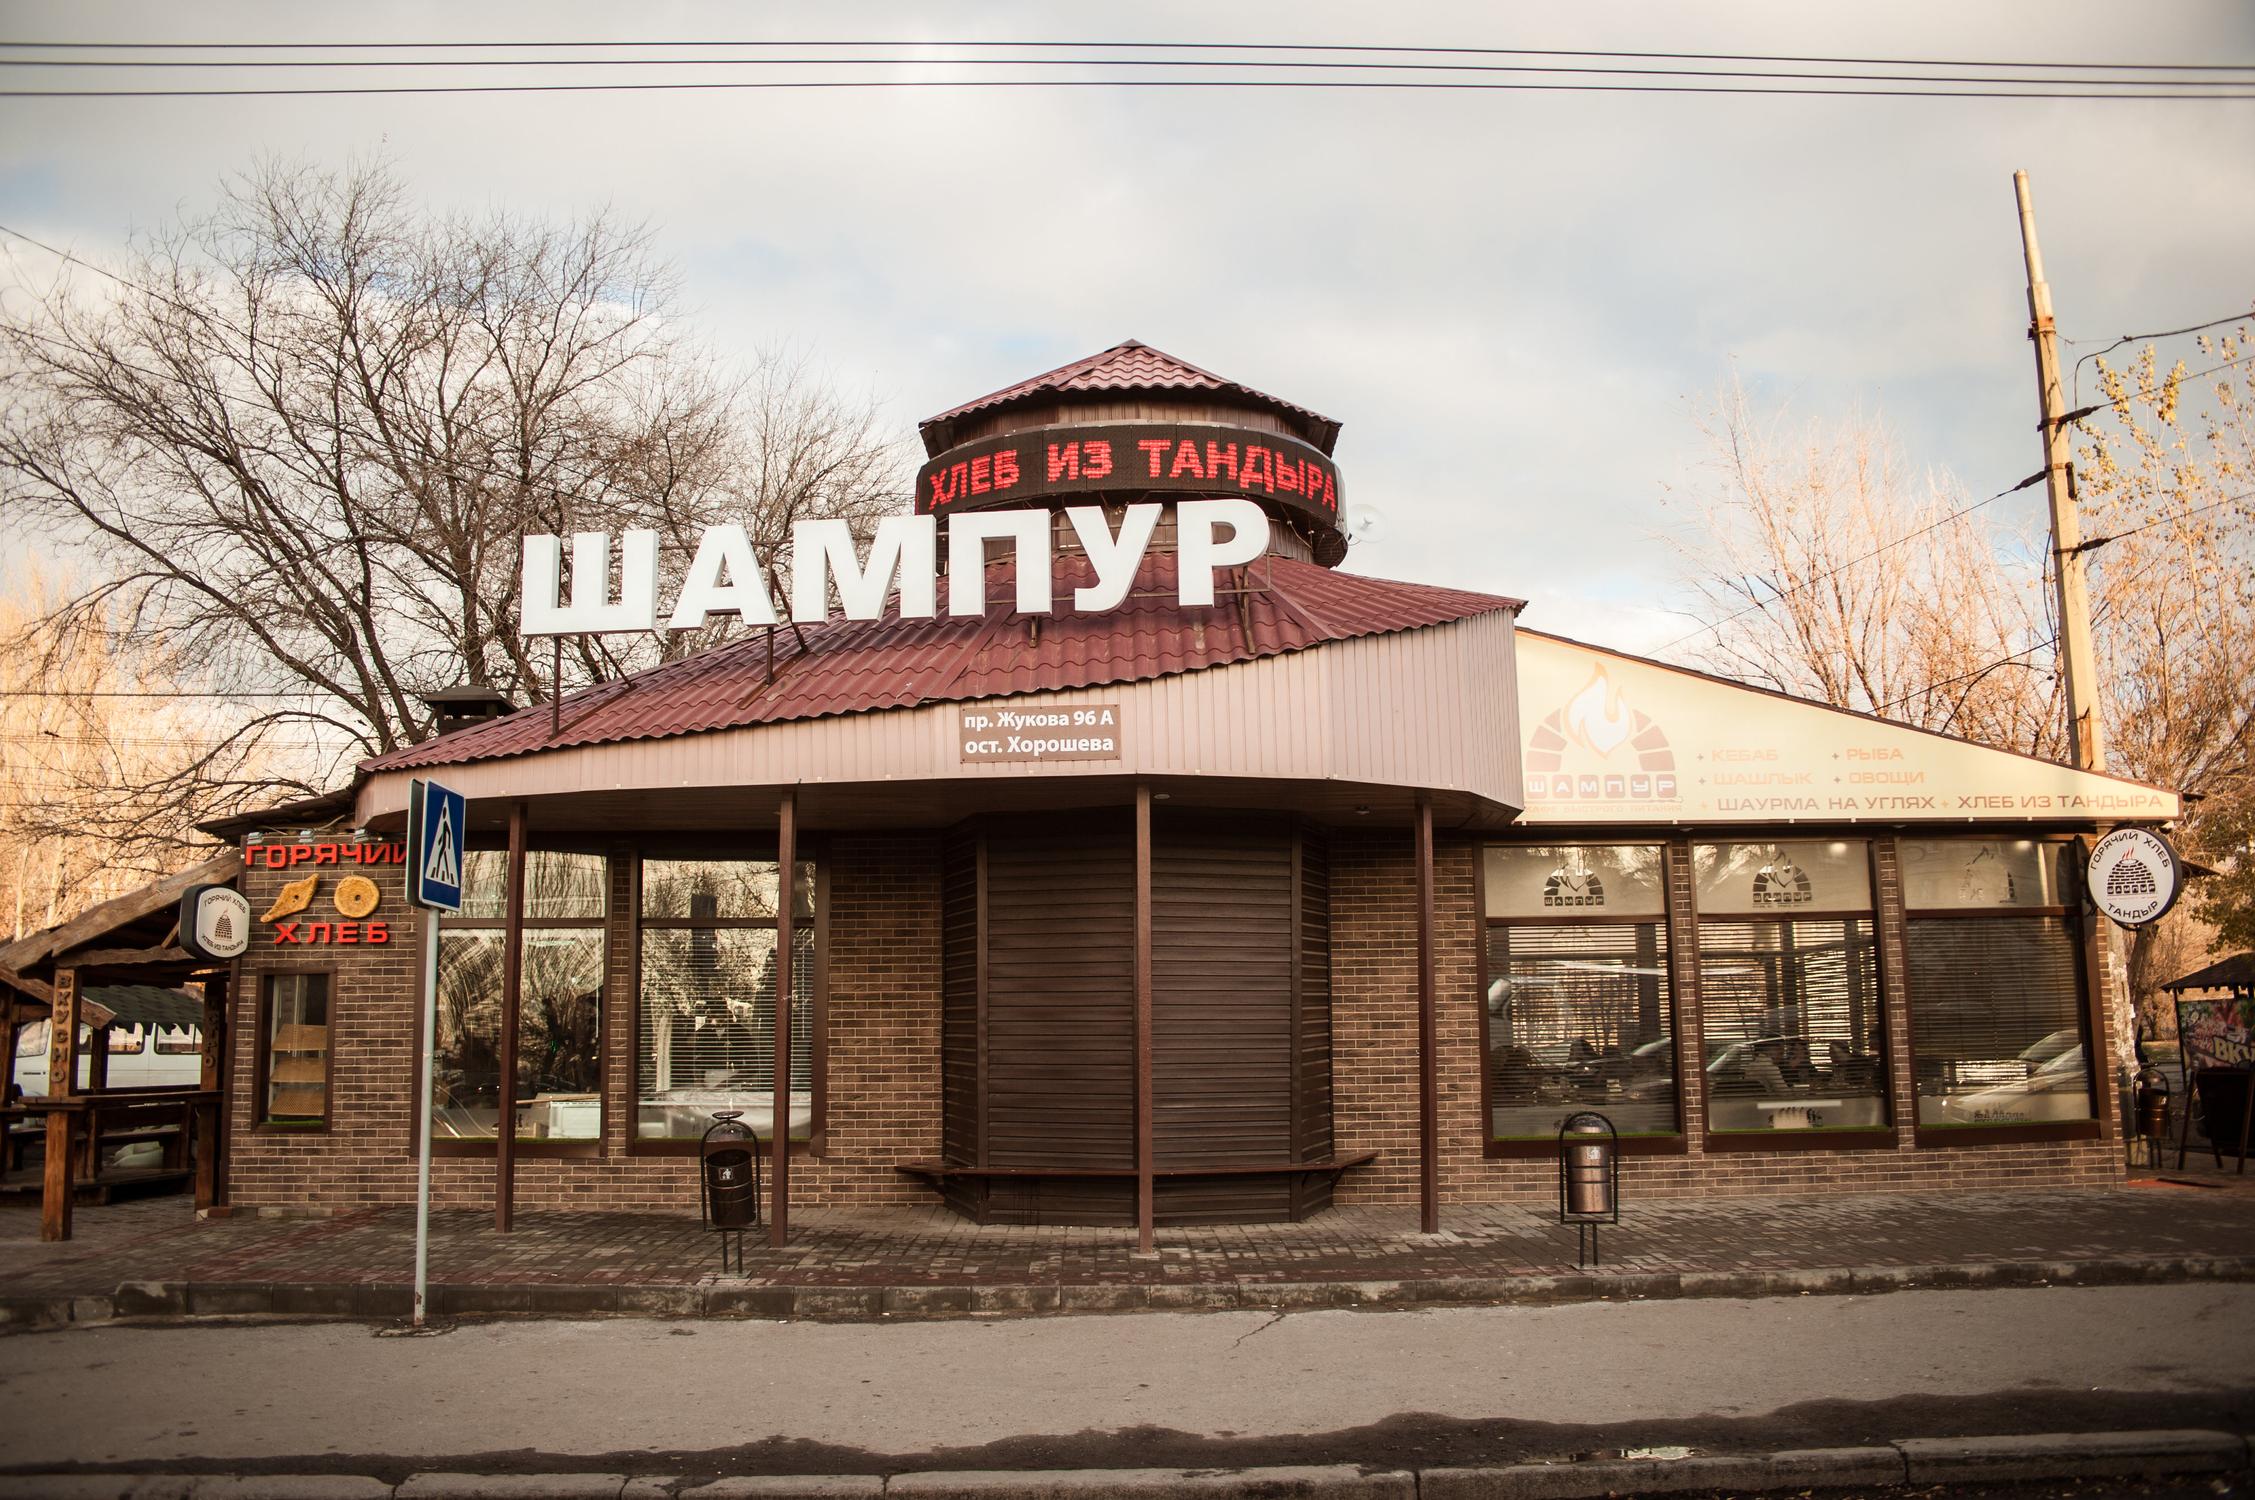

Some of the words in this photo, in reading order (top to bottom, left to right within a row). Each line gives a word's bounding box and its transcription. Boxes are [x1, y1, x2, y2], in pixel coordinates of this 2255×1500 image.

[928, 449, 1020, 511] ХЛЕБ
[1047, 440, 1112, 482] ИЗ
[1138, 439, 1337, 513] ТАНДЫРА
[520, 498, 1271, 636] ШАМПУР
[964, 715, 993, 732] пр.
[997, 711, 1069, 731] Жукова
[1073, 710, 1096, 726] 96
[1100, 709, 1114, 726] А
[965, 740, 1003, 754] ост.
[1007, 736, 1114, 756] Хорошева
[1711, 749, 1778, 762] КЕБАБ
[1846, 748, 1904, 761] РЫБА
[1527, 777, 1676, 795] ШАМПУР
[1713, 772, 1813, 785] ШАШЛЫК
[1848, 771, 1925, 785] ОВОЩИ
[1717, 798, 1820, 811] ШАУРМА
[1828, 797, 1860, 810] НА
[1865, 796, 1936, 810] УГЛЯХ
[1958, 796, 2015, 809] ХЛЕБ
[2021, 796, 2052, 808] ИЗ
[2056, 795, 2164, 811] ТАНДЫРА
[2090, 831, 2139, 870] ГОРЯЧИЙ
[2144, 837, 2170, 868] ХЛЕБ
[2108, 900, 2158, 920] ТАНДЫР
[274, 922, 389, 945] ХЛЕБ
[51, 975, 72, 1083] ВКУСНО
